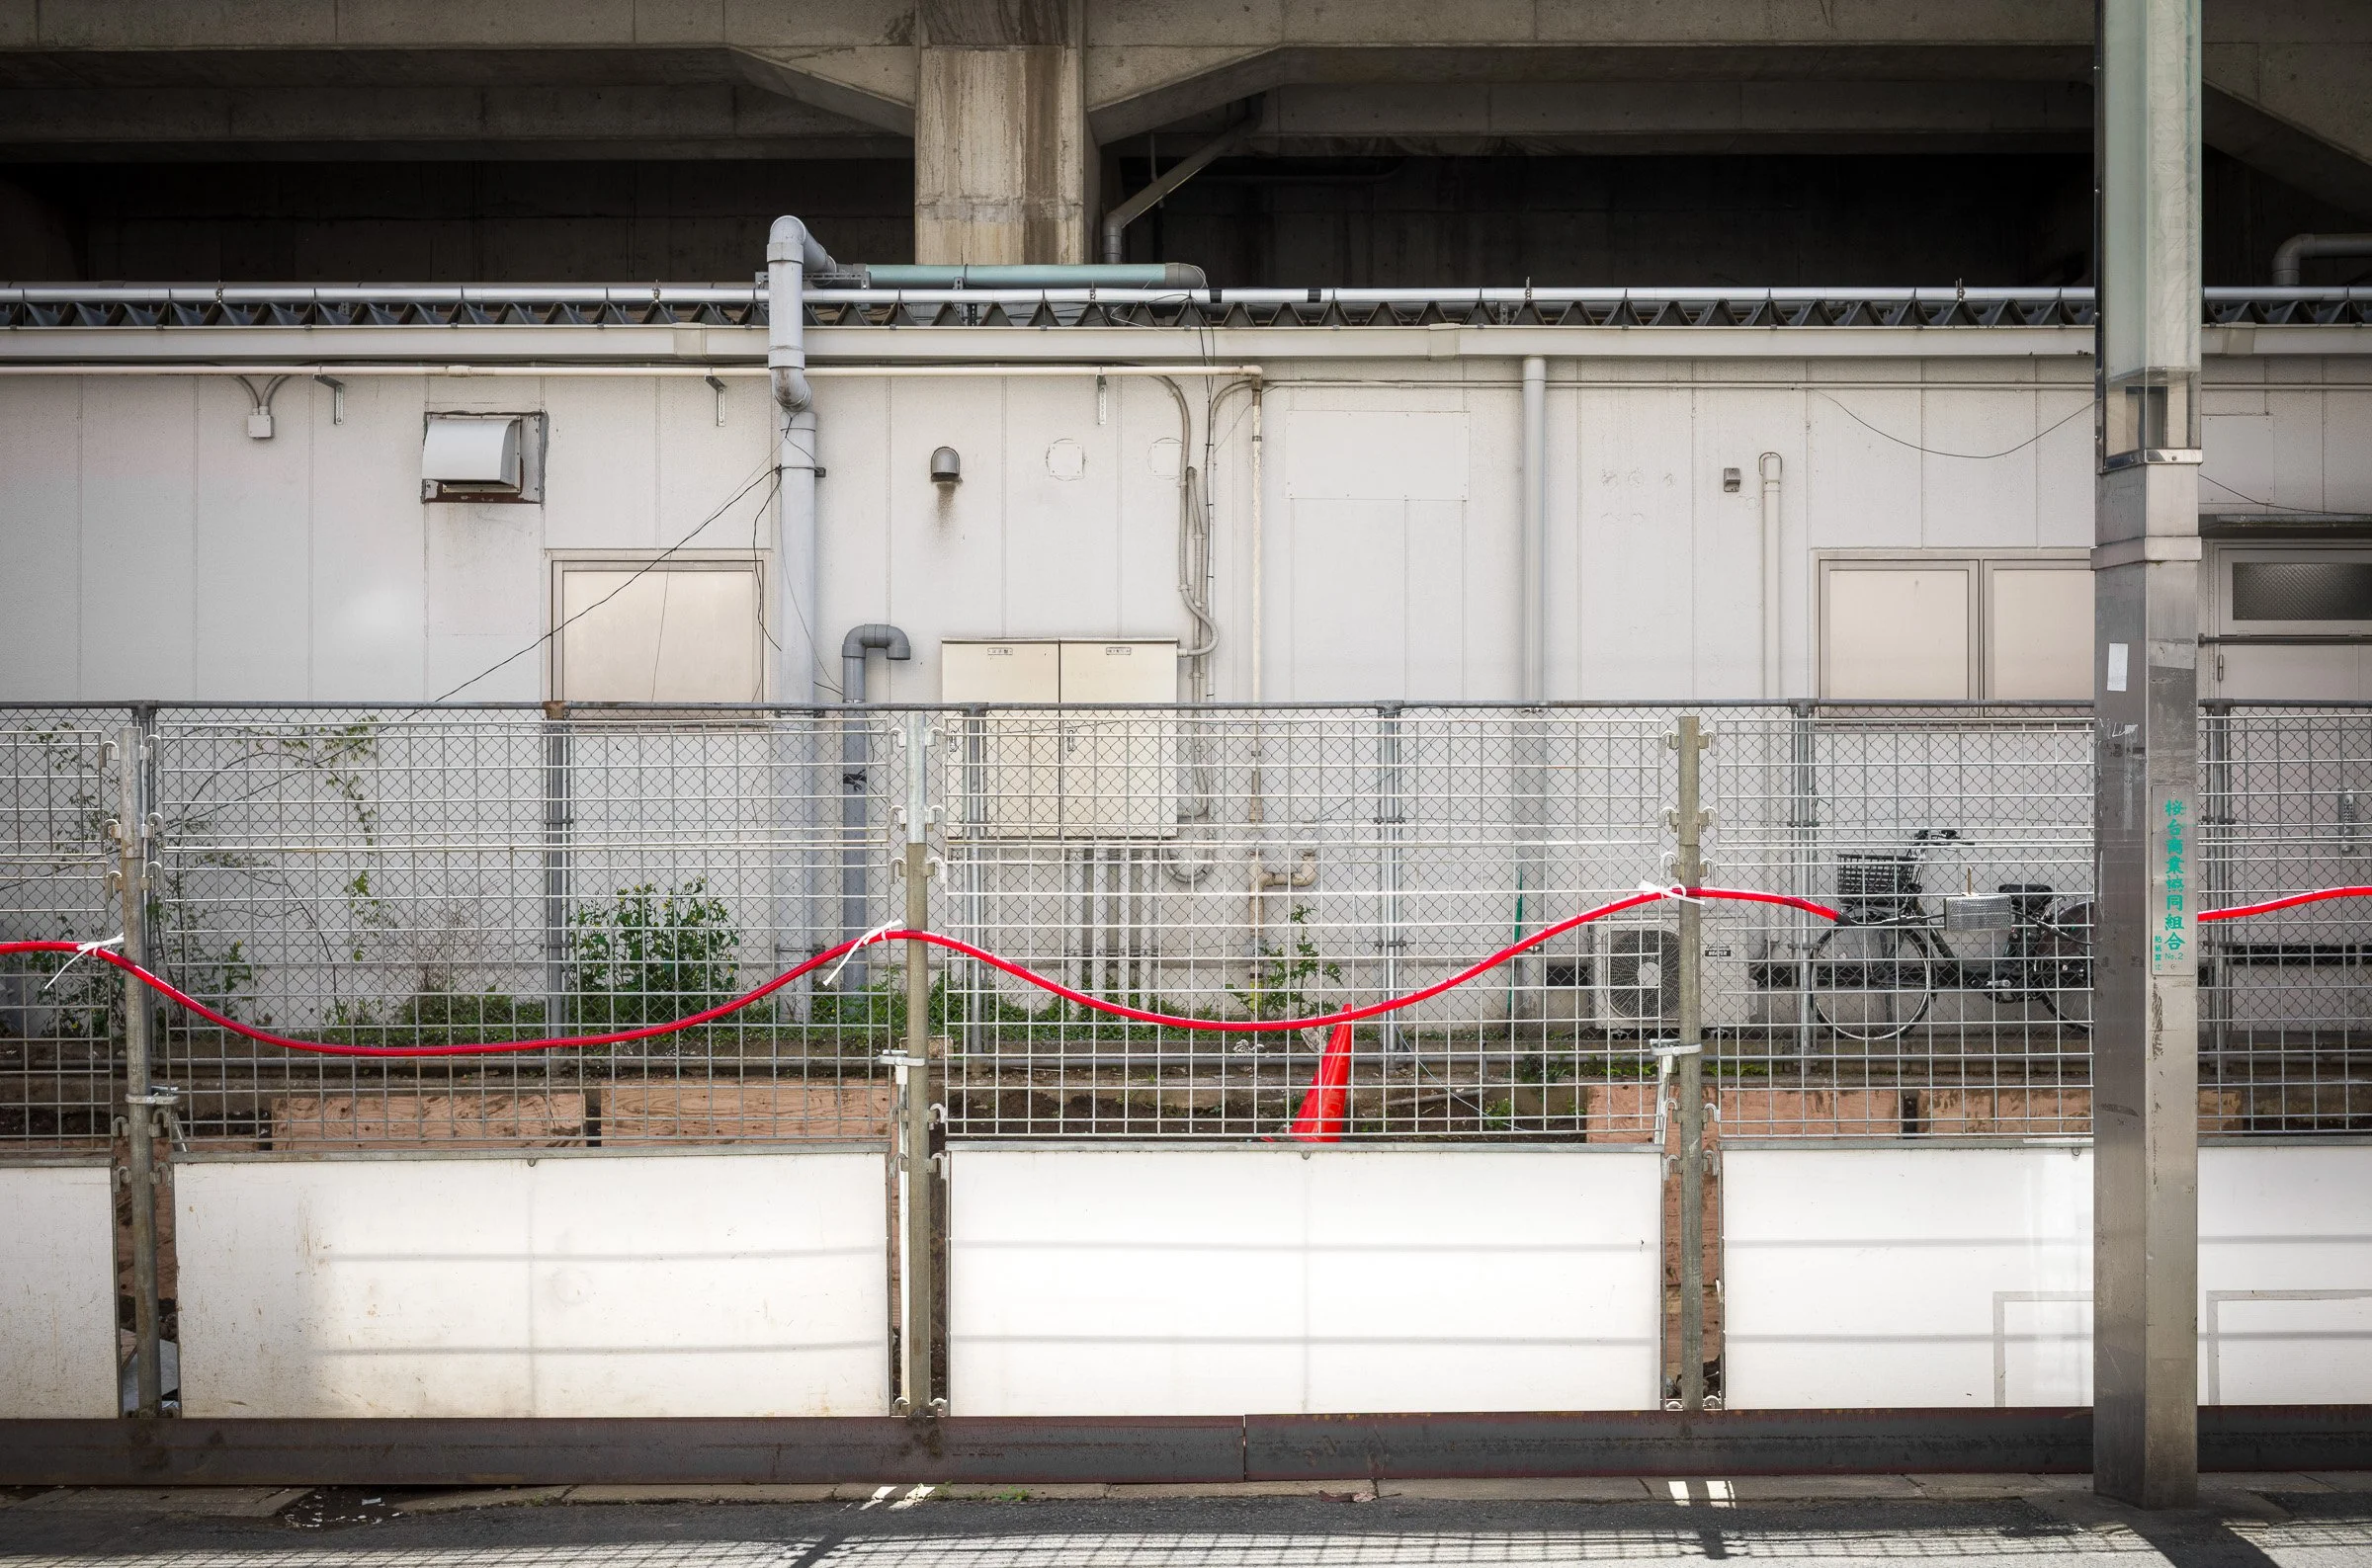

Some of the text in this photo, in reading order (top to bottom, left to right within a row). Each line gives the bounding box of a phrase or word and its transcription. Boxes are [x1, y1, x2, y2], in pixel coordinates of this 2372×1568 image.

[2163, 798, 2186, 950] 桜台商業協同組合
[2164, 951, 2184, 960] No.2
